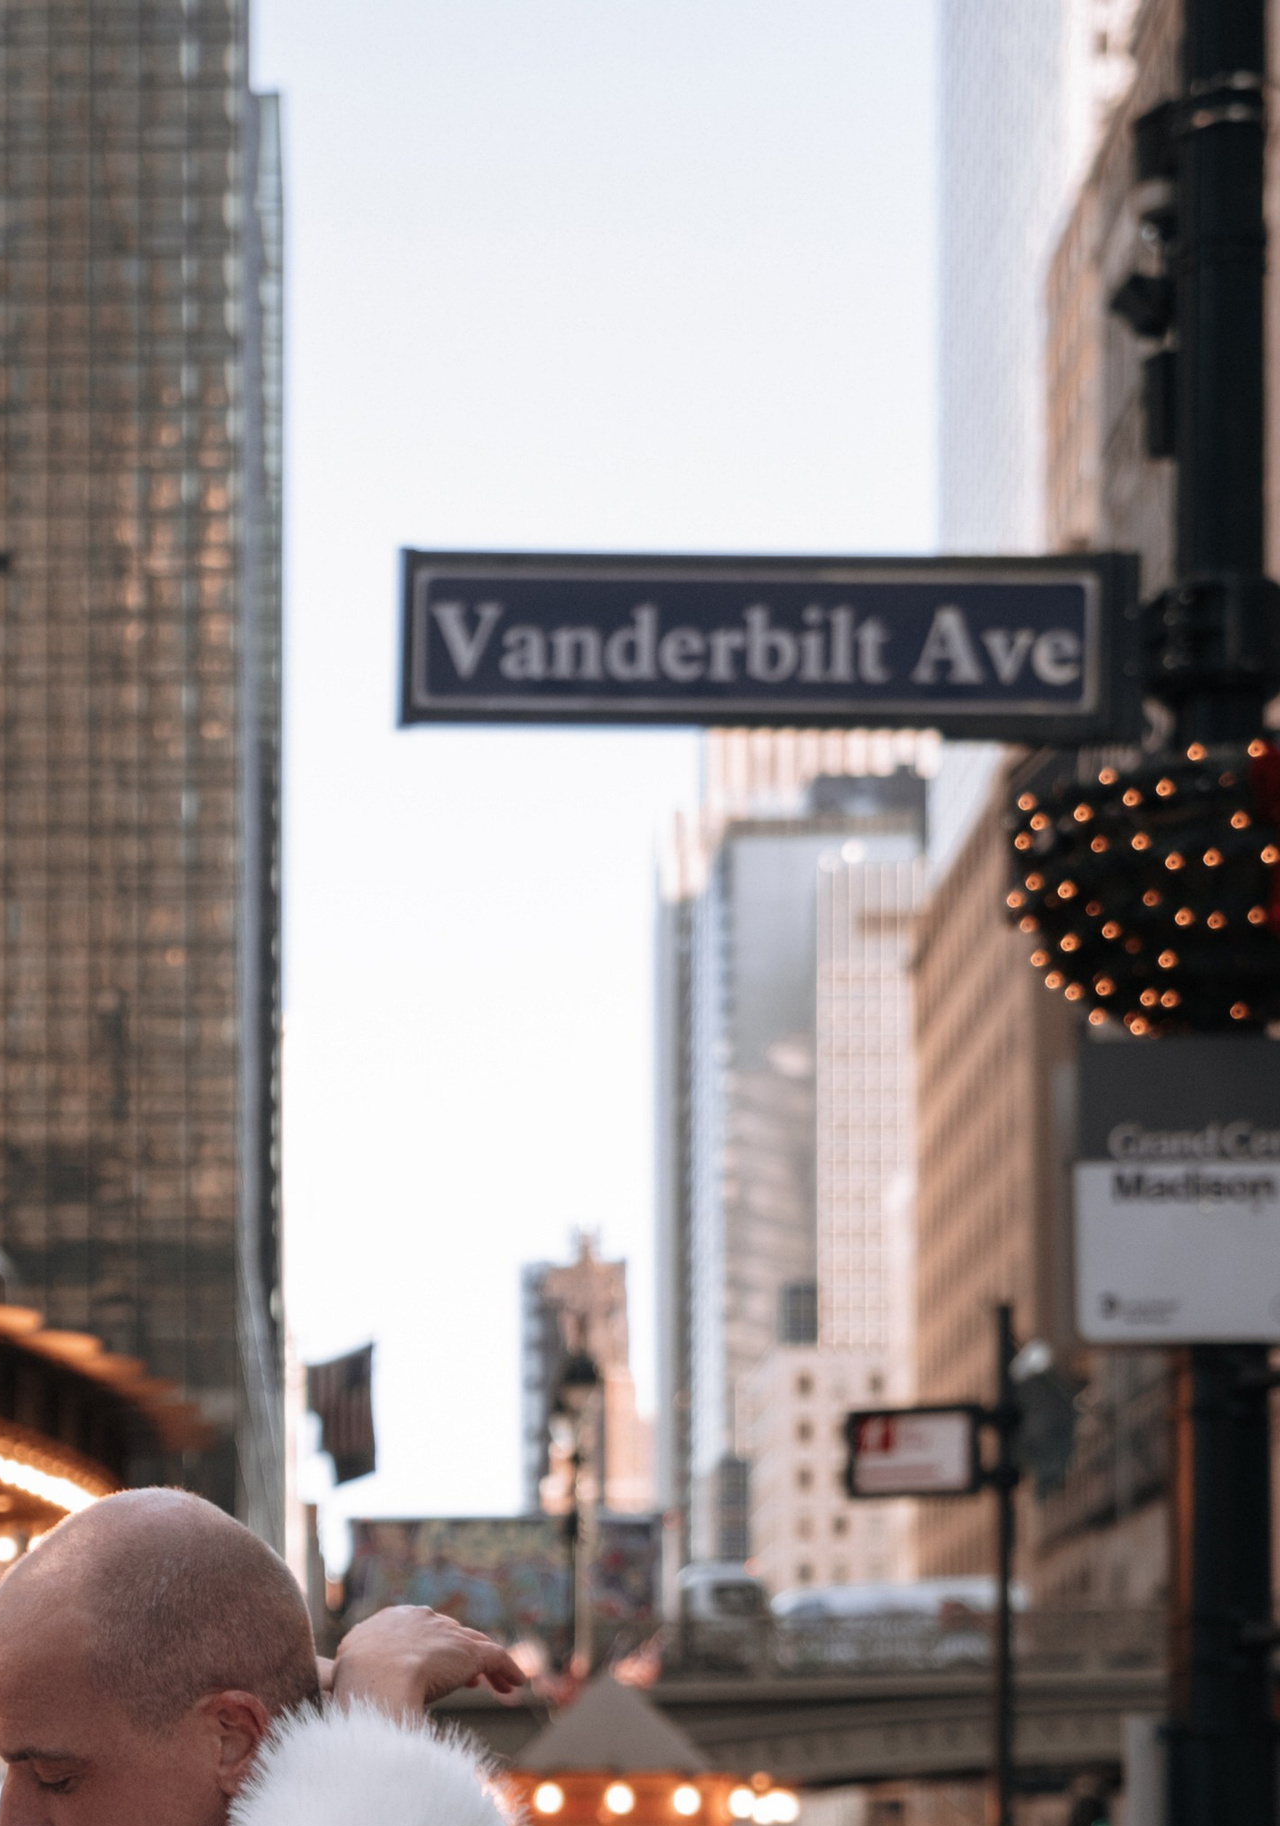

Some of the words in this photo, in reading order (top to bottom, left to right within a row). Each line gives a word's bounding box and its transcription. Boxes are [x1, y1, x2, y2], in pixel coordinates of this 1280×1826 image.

[431, 602, 890, 684] Vanderbilt
[912, 606, 1080, 686] Ave
[1108, 1121, 1219, 1159] Grand
[1114, 1167, 1276, 1203] Madison
